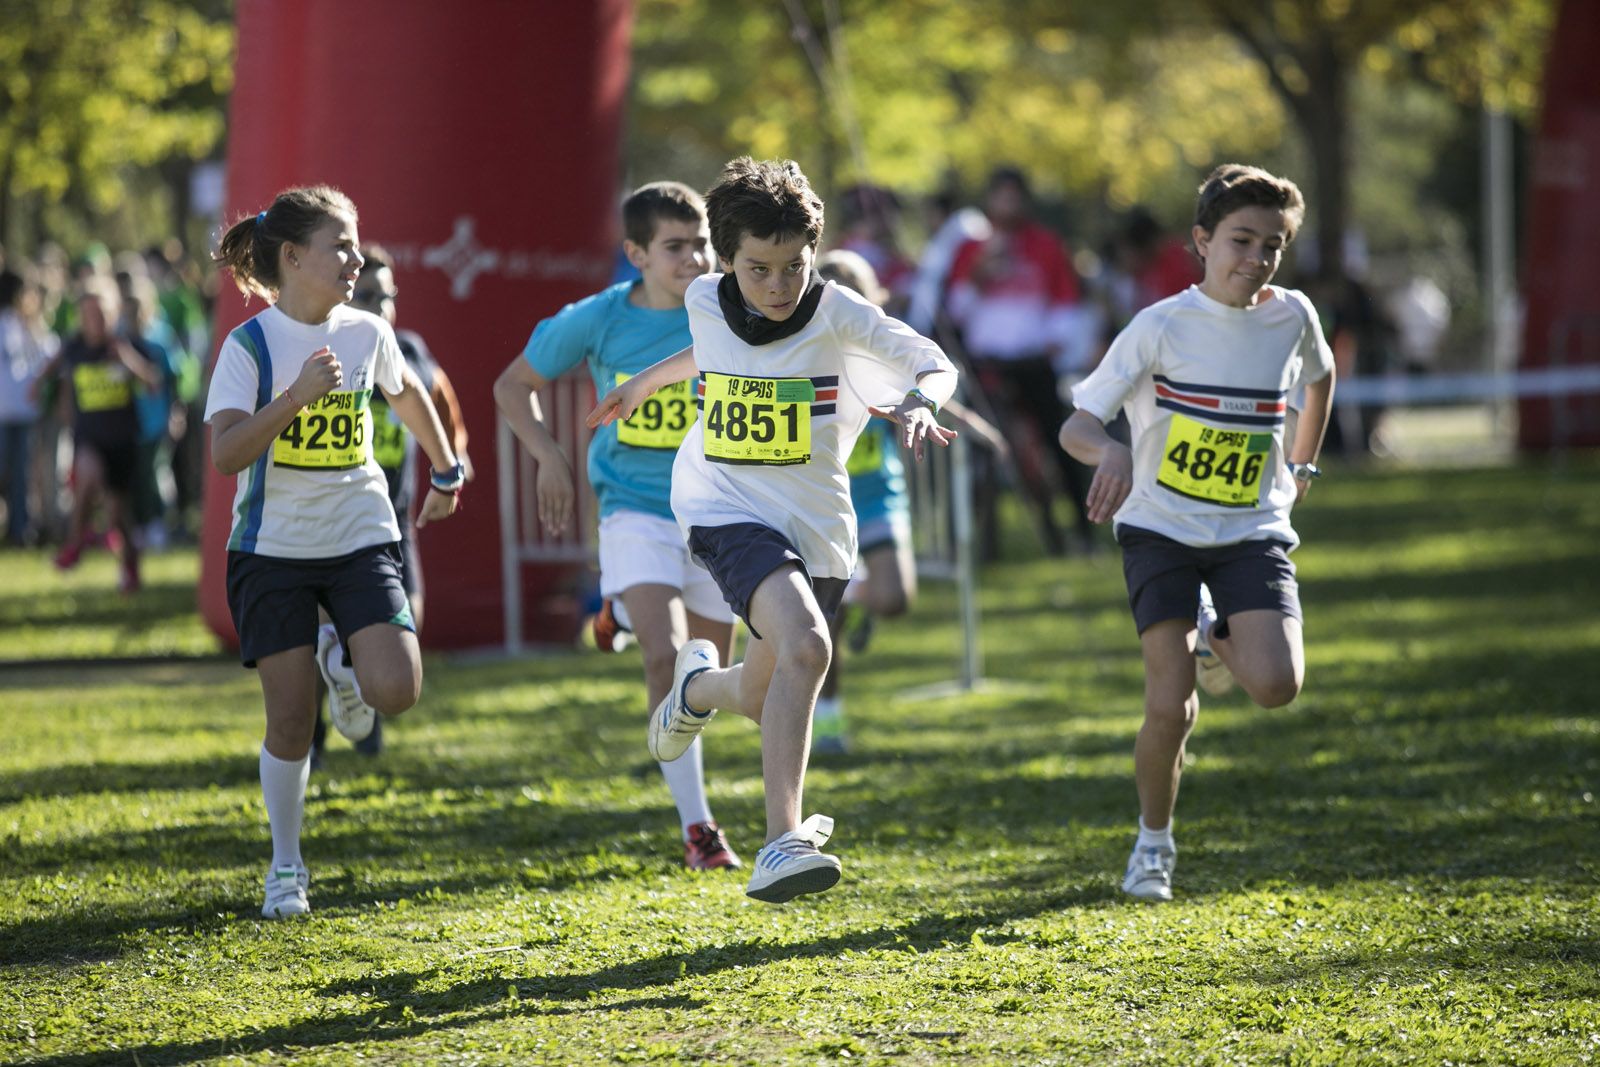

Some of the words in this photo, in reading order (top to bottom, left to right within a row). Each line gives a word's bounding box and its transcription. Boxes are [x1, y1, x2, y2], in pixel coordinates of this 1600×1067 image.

[322, 393, 352, 410] CROS
[728, 378, 740, 396] 19
[741, 380, 774, 398] CROS
[279, 412, 364, 451] 4295
[707, 400, 798, 443] 4851
[1199, 427, 1214, 443] 19
[1214, 431, 1248, 448] CROS
[1168, 440, 1262, 487] 4846
